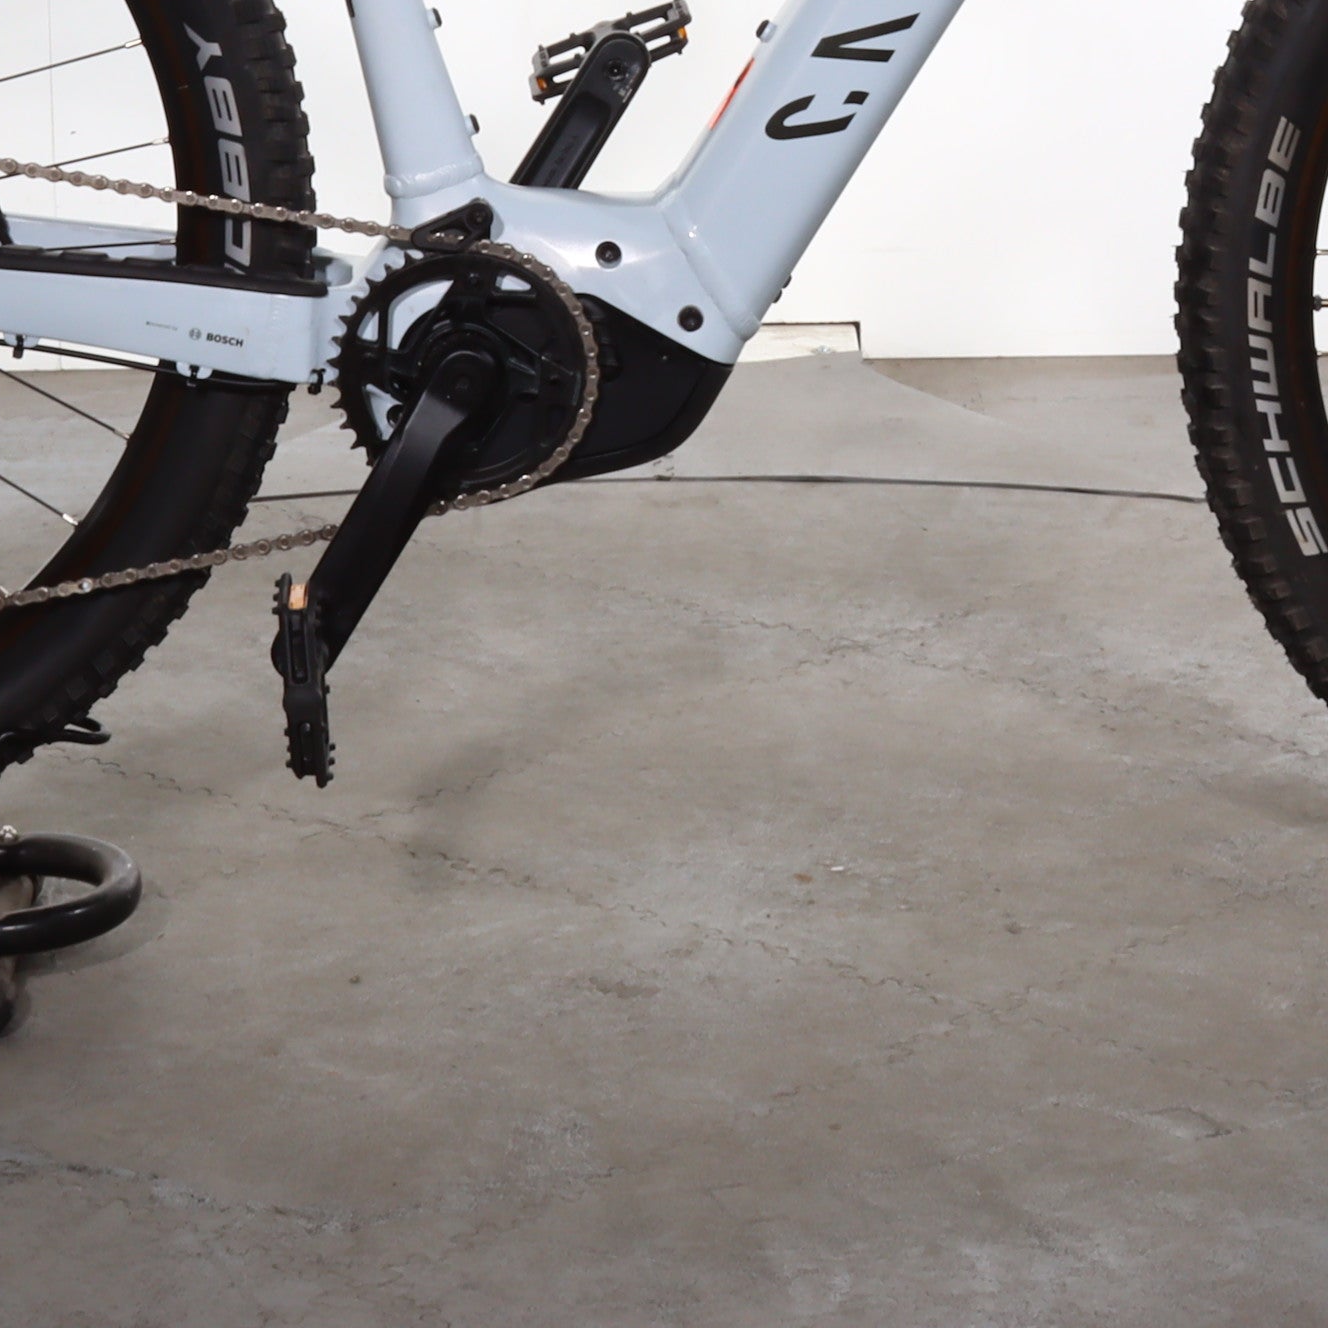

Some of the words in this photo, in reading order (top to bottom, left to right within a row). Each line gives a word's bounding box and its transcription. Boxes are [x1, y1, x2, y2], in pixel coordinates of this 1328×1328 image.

[185, 21, 252, 275] OBBY
[206, 332, 244, 348] BOSCH
[1247, 116, 1328, 557] SCHWALBE
